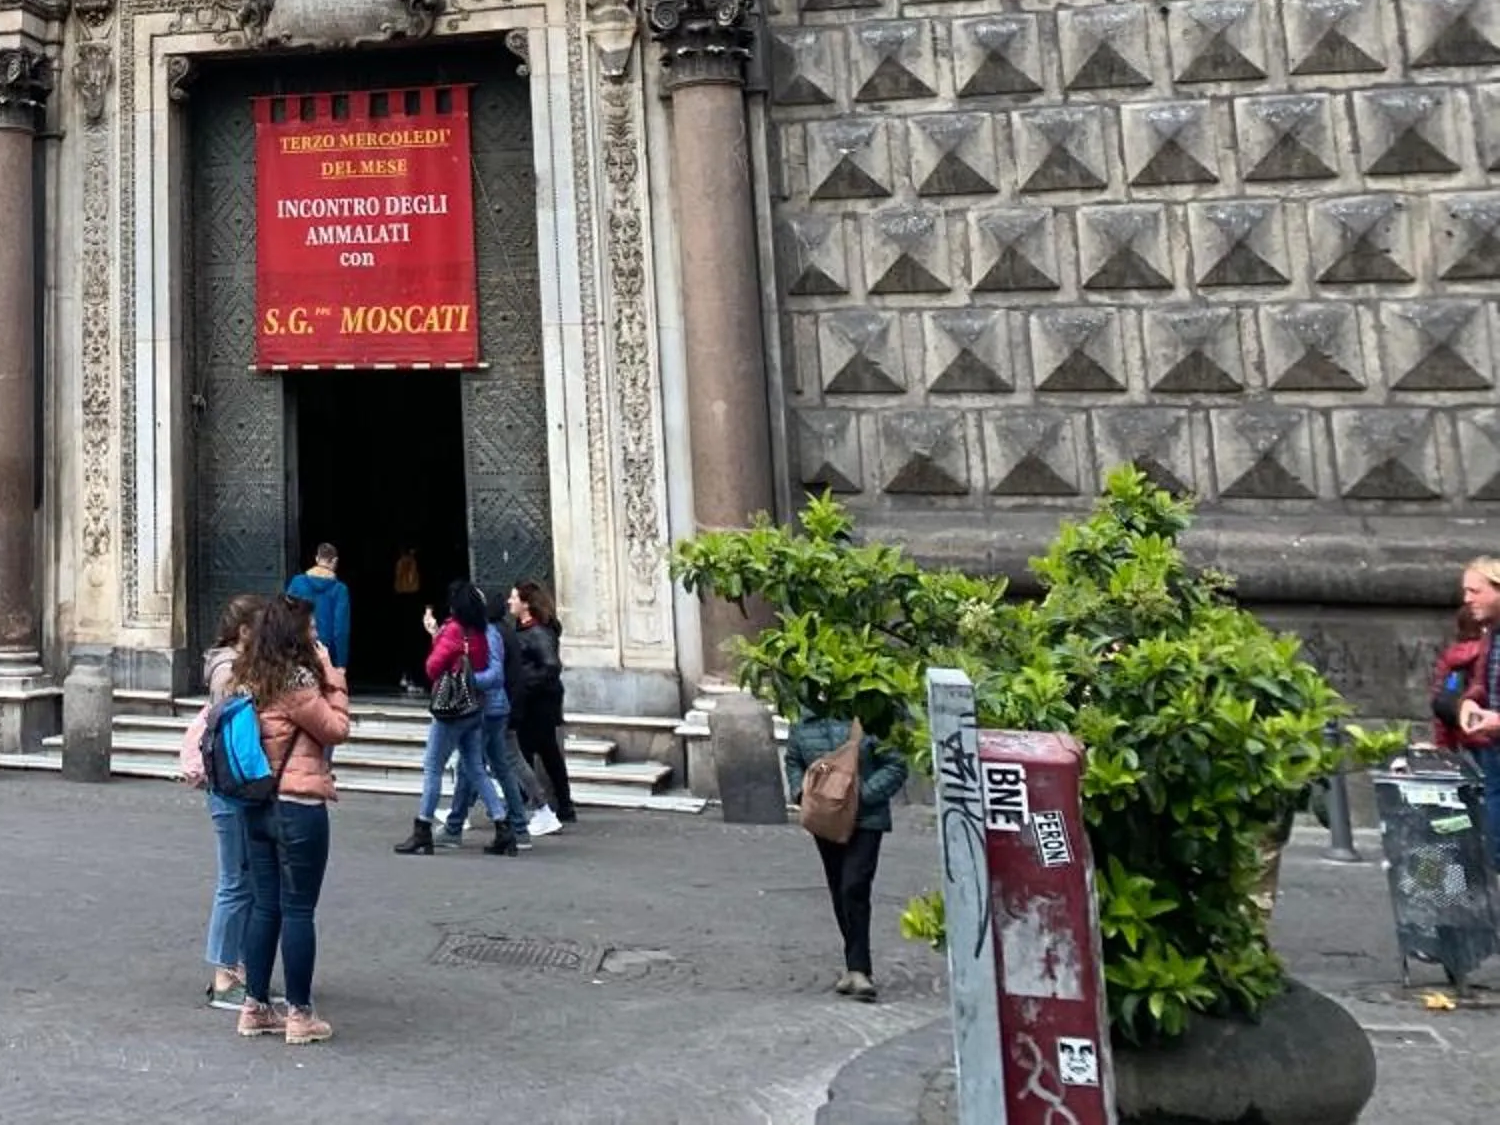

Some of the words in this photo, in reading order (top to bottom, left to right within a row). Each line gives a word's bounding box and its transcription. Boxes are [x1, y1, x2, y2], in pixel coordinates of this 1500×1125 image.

[280, 134, 335, 151] TERZO
[321, 161, 357, 177] DEL
[360, 158, 408, 175] MESE
[277, 196, 380, 219] INCONTRO
[385, 194, 448, 216] DEGLI
[305, 223, 411, 246] AMMALATI
[339, 251, 375, 267] con
[339, 305, 470, 334] MOSCATI
[987, 768, 1024, 825] BNE
